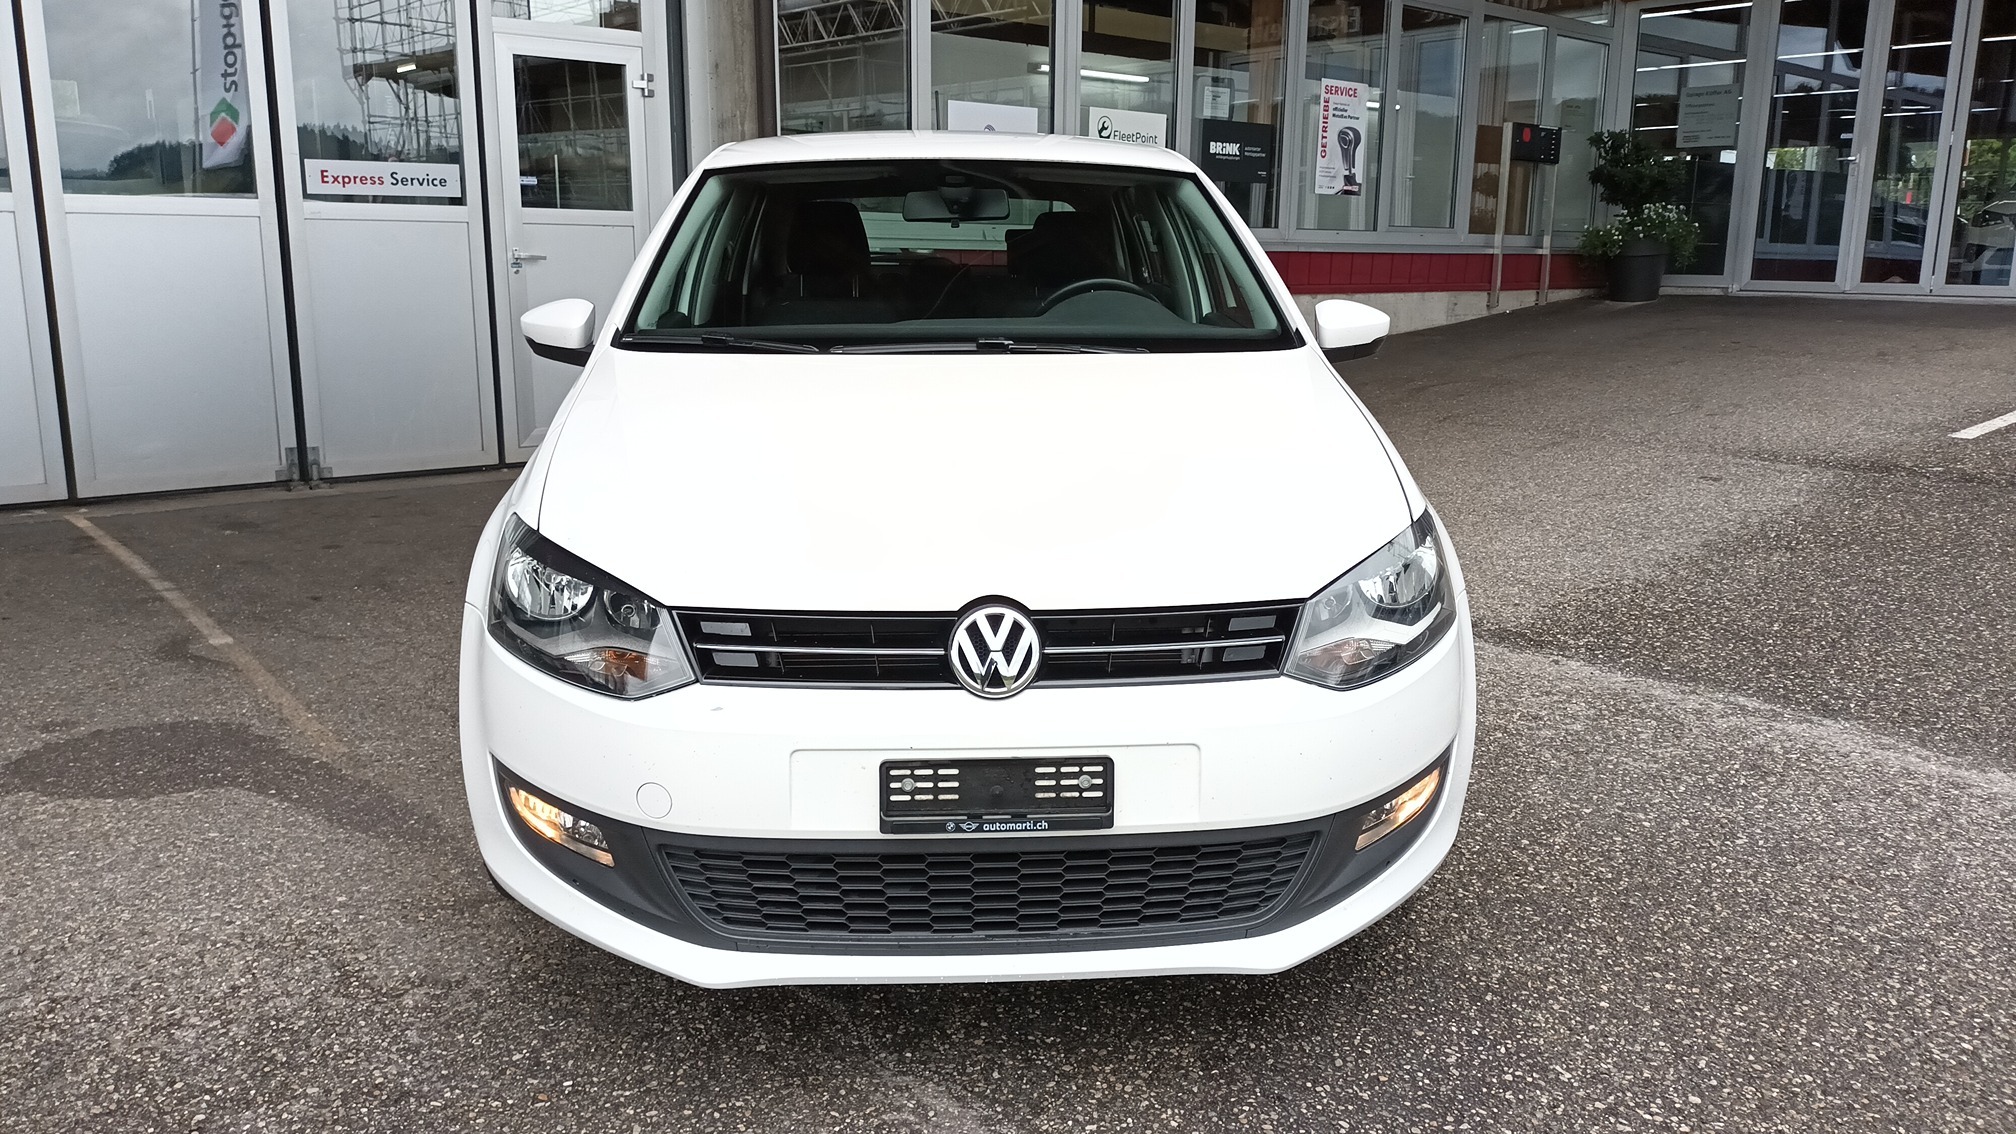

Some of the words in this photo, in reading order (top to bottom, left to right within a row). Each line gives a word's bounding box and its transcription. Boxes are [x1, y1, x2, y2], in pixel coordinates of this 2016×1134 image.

[219, 0, 242, 93] stop+g
[1324, 84, 1358, 98] SERVICE
[1320, 96, 1330, 159] GETRIEBE
[1113, 130, 1158, 144] FleetPoint
[320, 169, 385, 188] Express
[390, 171, 447, 187] Service
[983, 820, 1048, 831] automarti.ch
